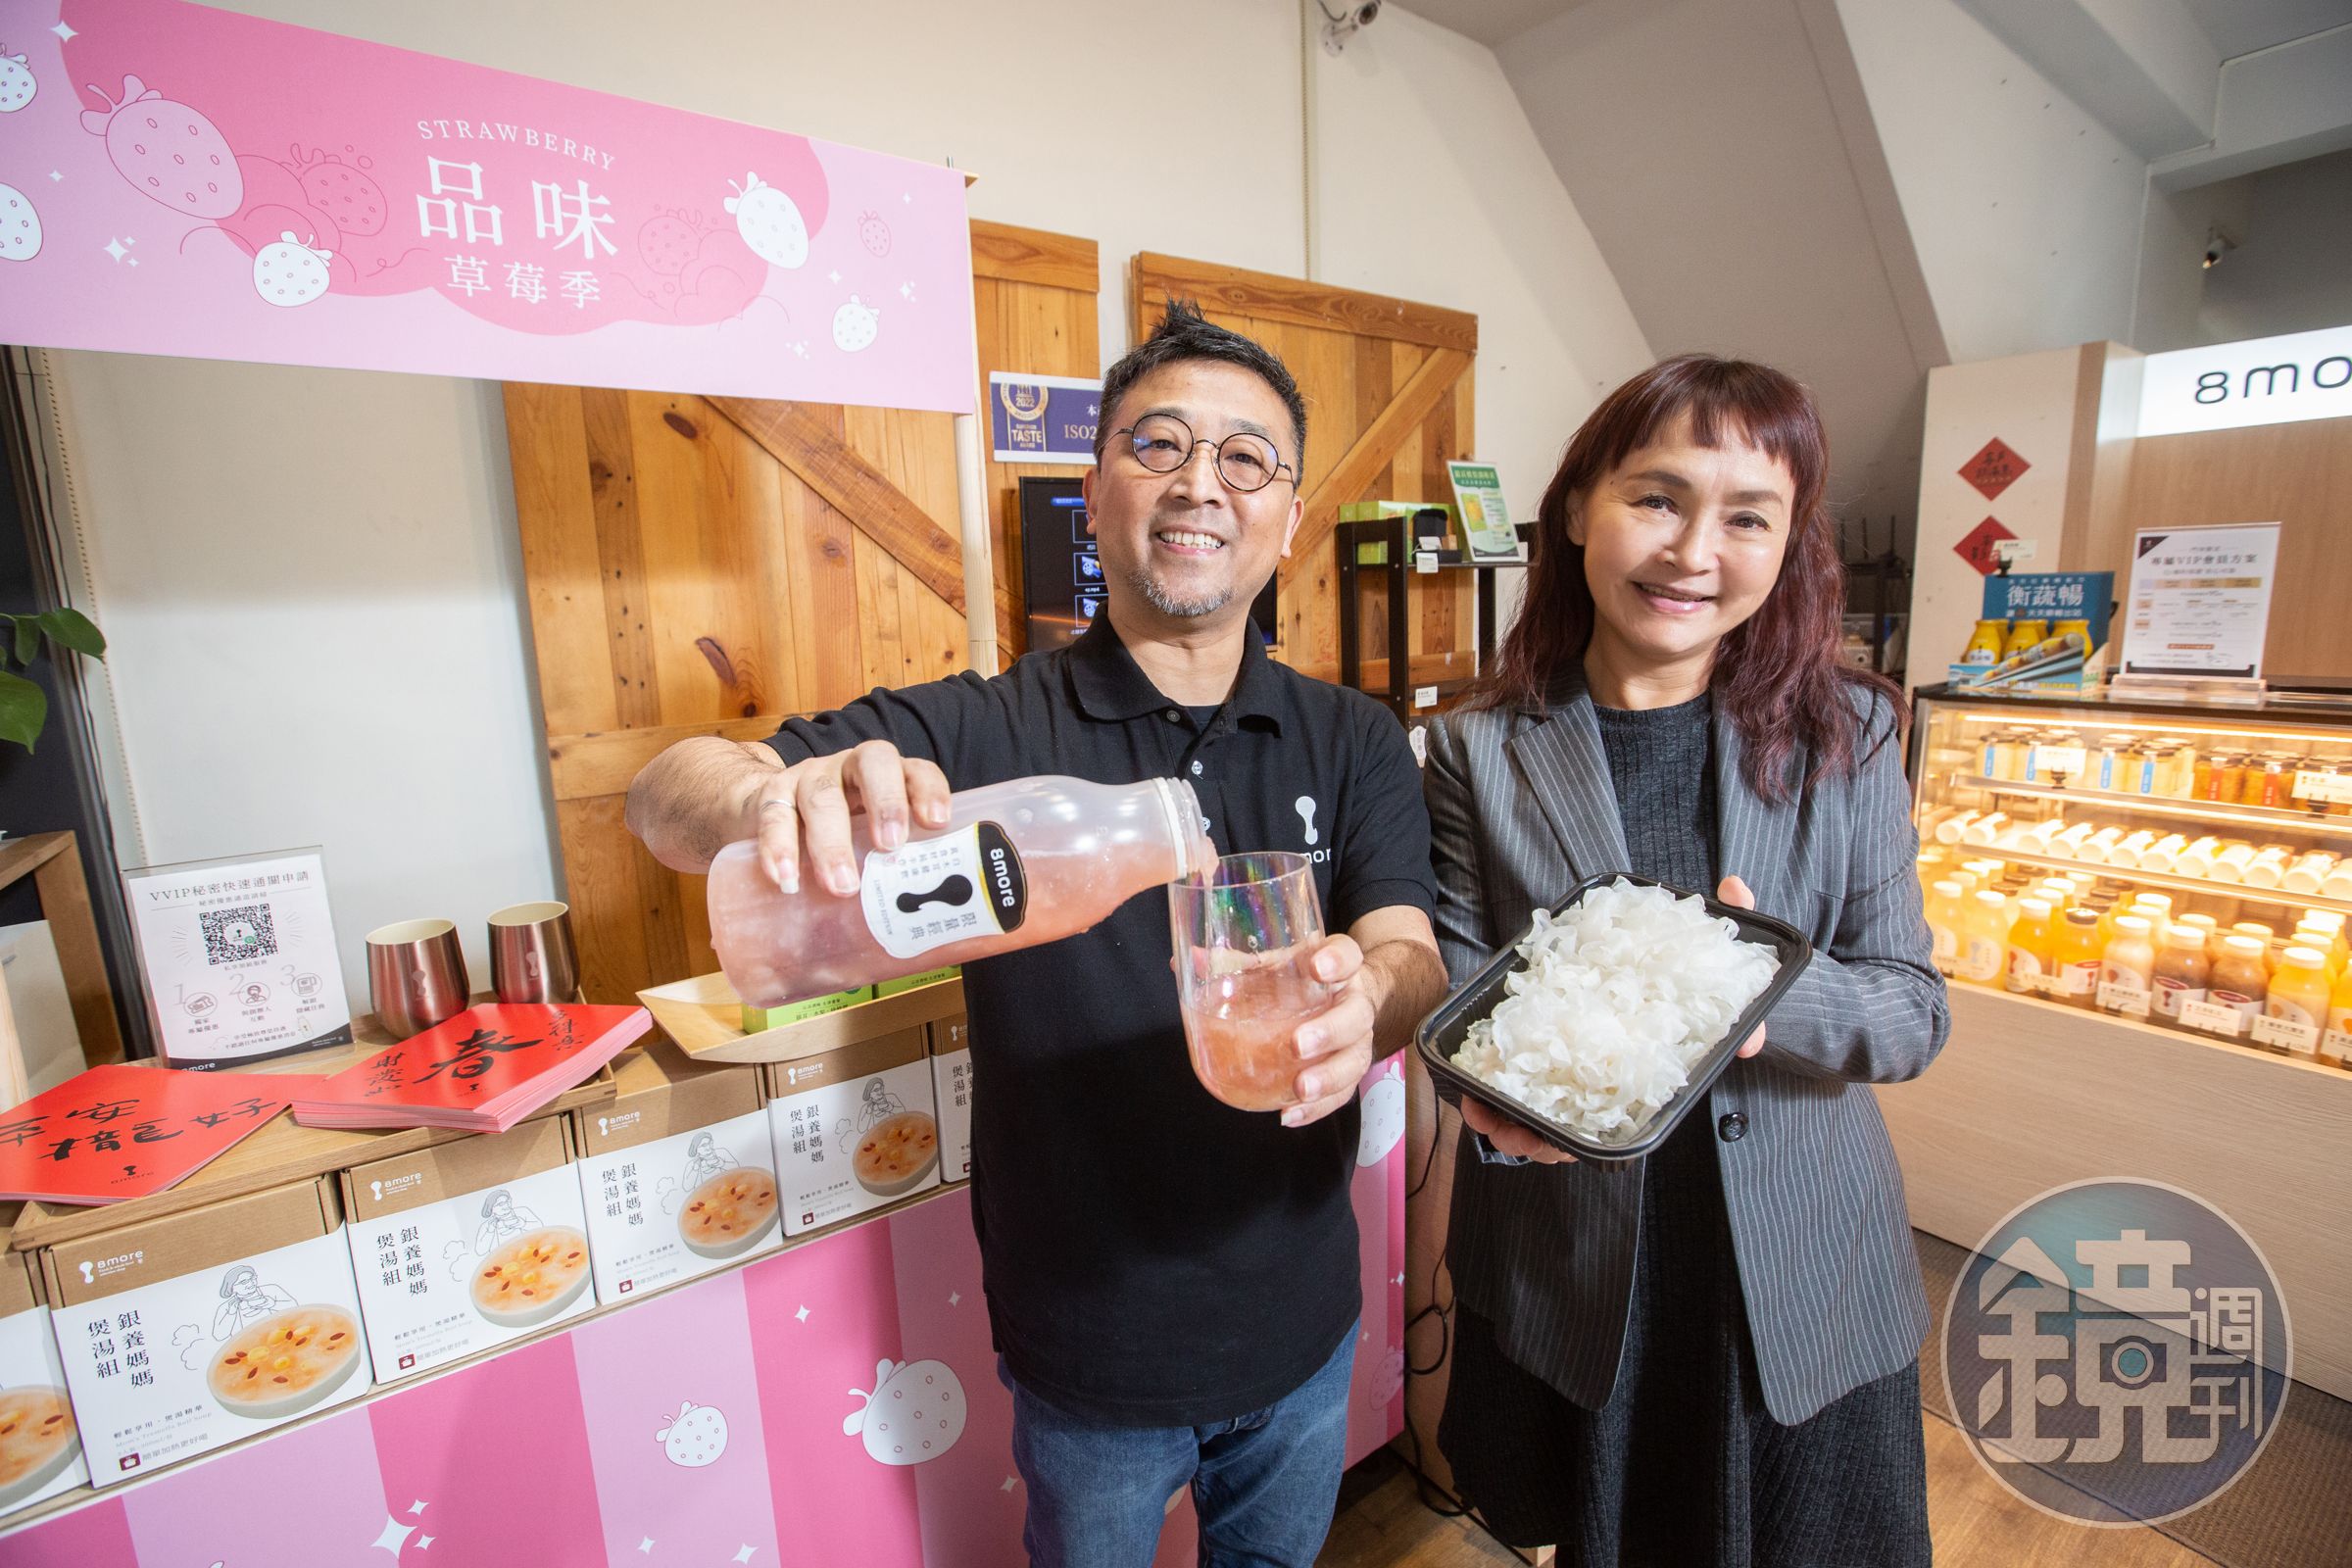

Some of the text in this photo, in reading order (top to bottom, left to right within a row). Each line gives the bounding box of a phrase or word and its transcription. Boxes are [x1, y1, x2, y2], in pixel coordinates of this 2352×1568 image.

[416, 118, 616, 172] STRAWBERRY
[415, 155, 619, 262] 品味
[444, 253, 603, 309] 草莓季
[1011, 429, 1043, 443] TASTE
[1064, 424, 1098, 440] ISO2
[2007, 583, 2084, 608] 衡蔬暢
[989, 846, 1015, 908] 8more
[413, 1028, 545, 1085] 春
[790, 1109, 807, 1153] 煲湯組
[807, 1104, 824, 1163] 銀養媽媽
[602, 1170, 623, 1216] 煲湯組
[621, 1162, 644, 1226] 銀養媽媽
[97, 1250, 144, 1268] 8more
[377, 1232, 402, 1287] 煲湯組
[400, 1225, 428, 1296] 銀養媽媽
[87, 1319, 121, 1379] 煲湯組
[118, 1309, 154, 1390] 銀養媽媽
